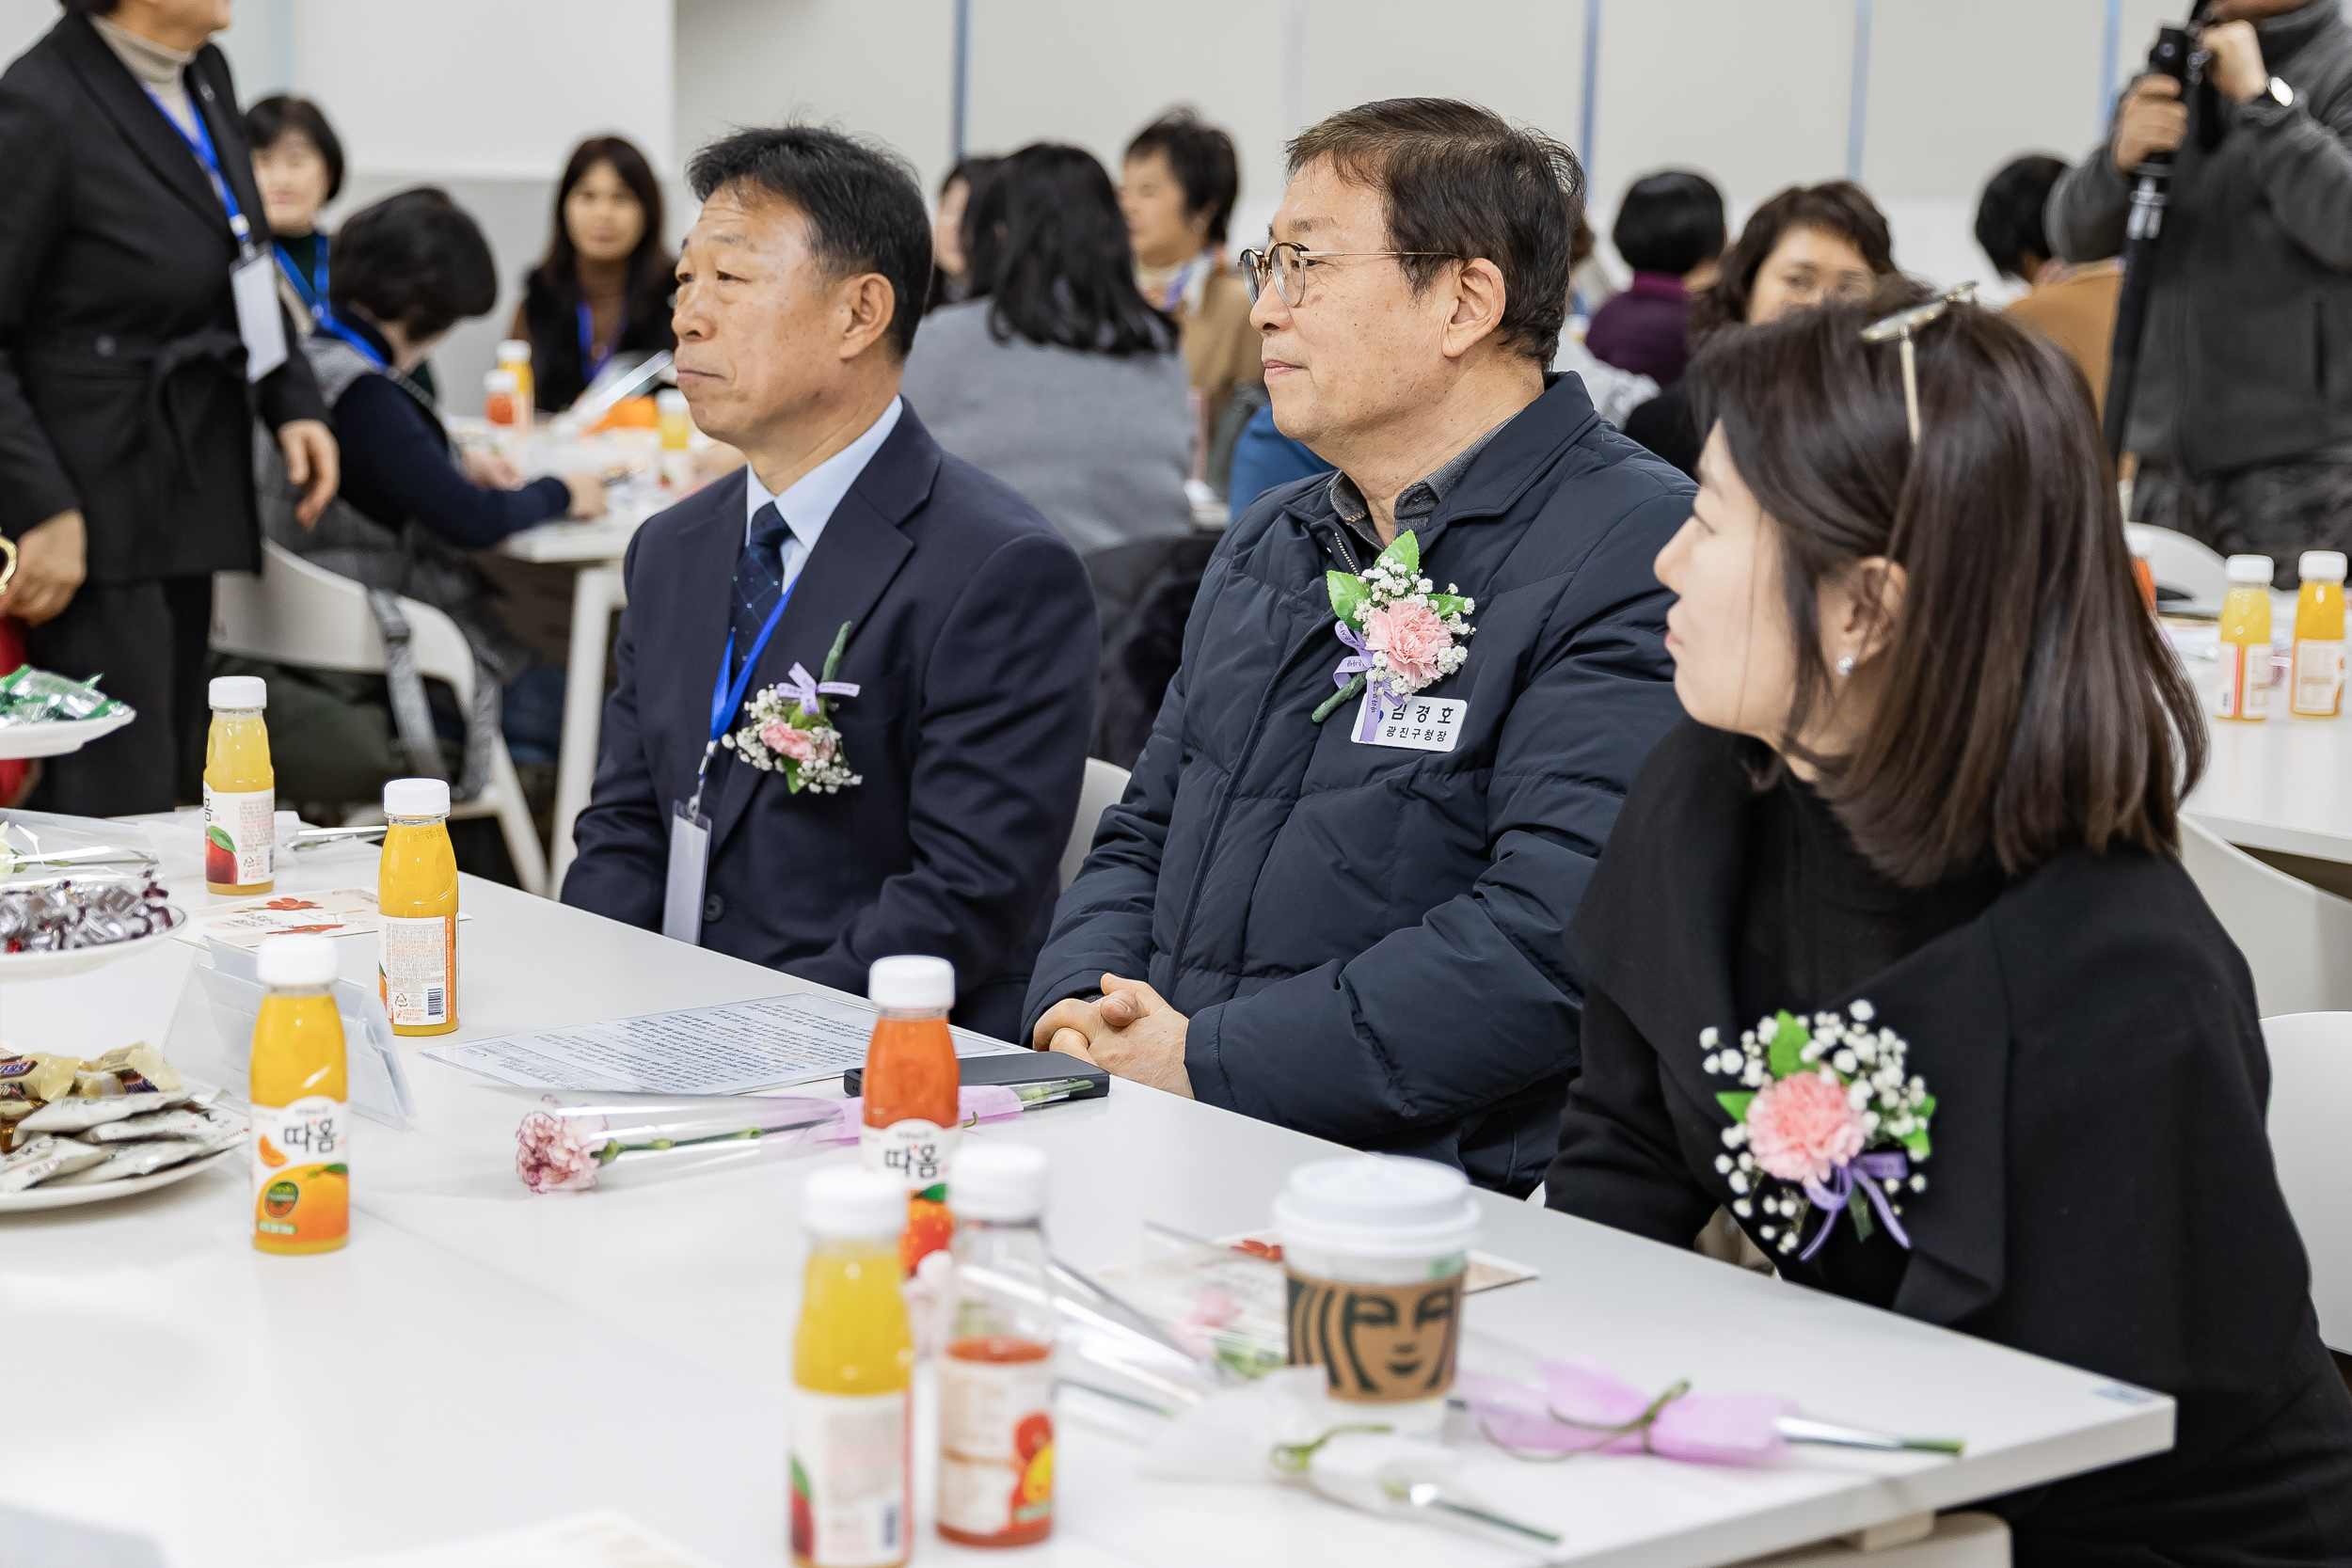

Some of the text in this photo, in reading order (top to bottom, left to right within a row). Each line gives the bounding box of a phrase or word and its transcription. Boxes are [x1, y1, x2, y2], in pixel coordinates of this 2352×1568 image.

[1391, 703, 1454, 724] 김경호
[1386, 726, 1448, 743] 광진구청장
[284, 1118, 337, 1153] 따옴
[884, 1144, 941, 1179] 따옴
